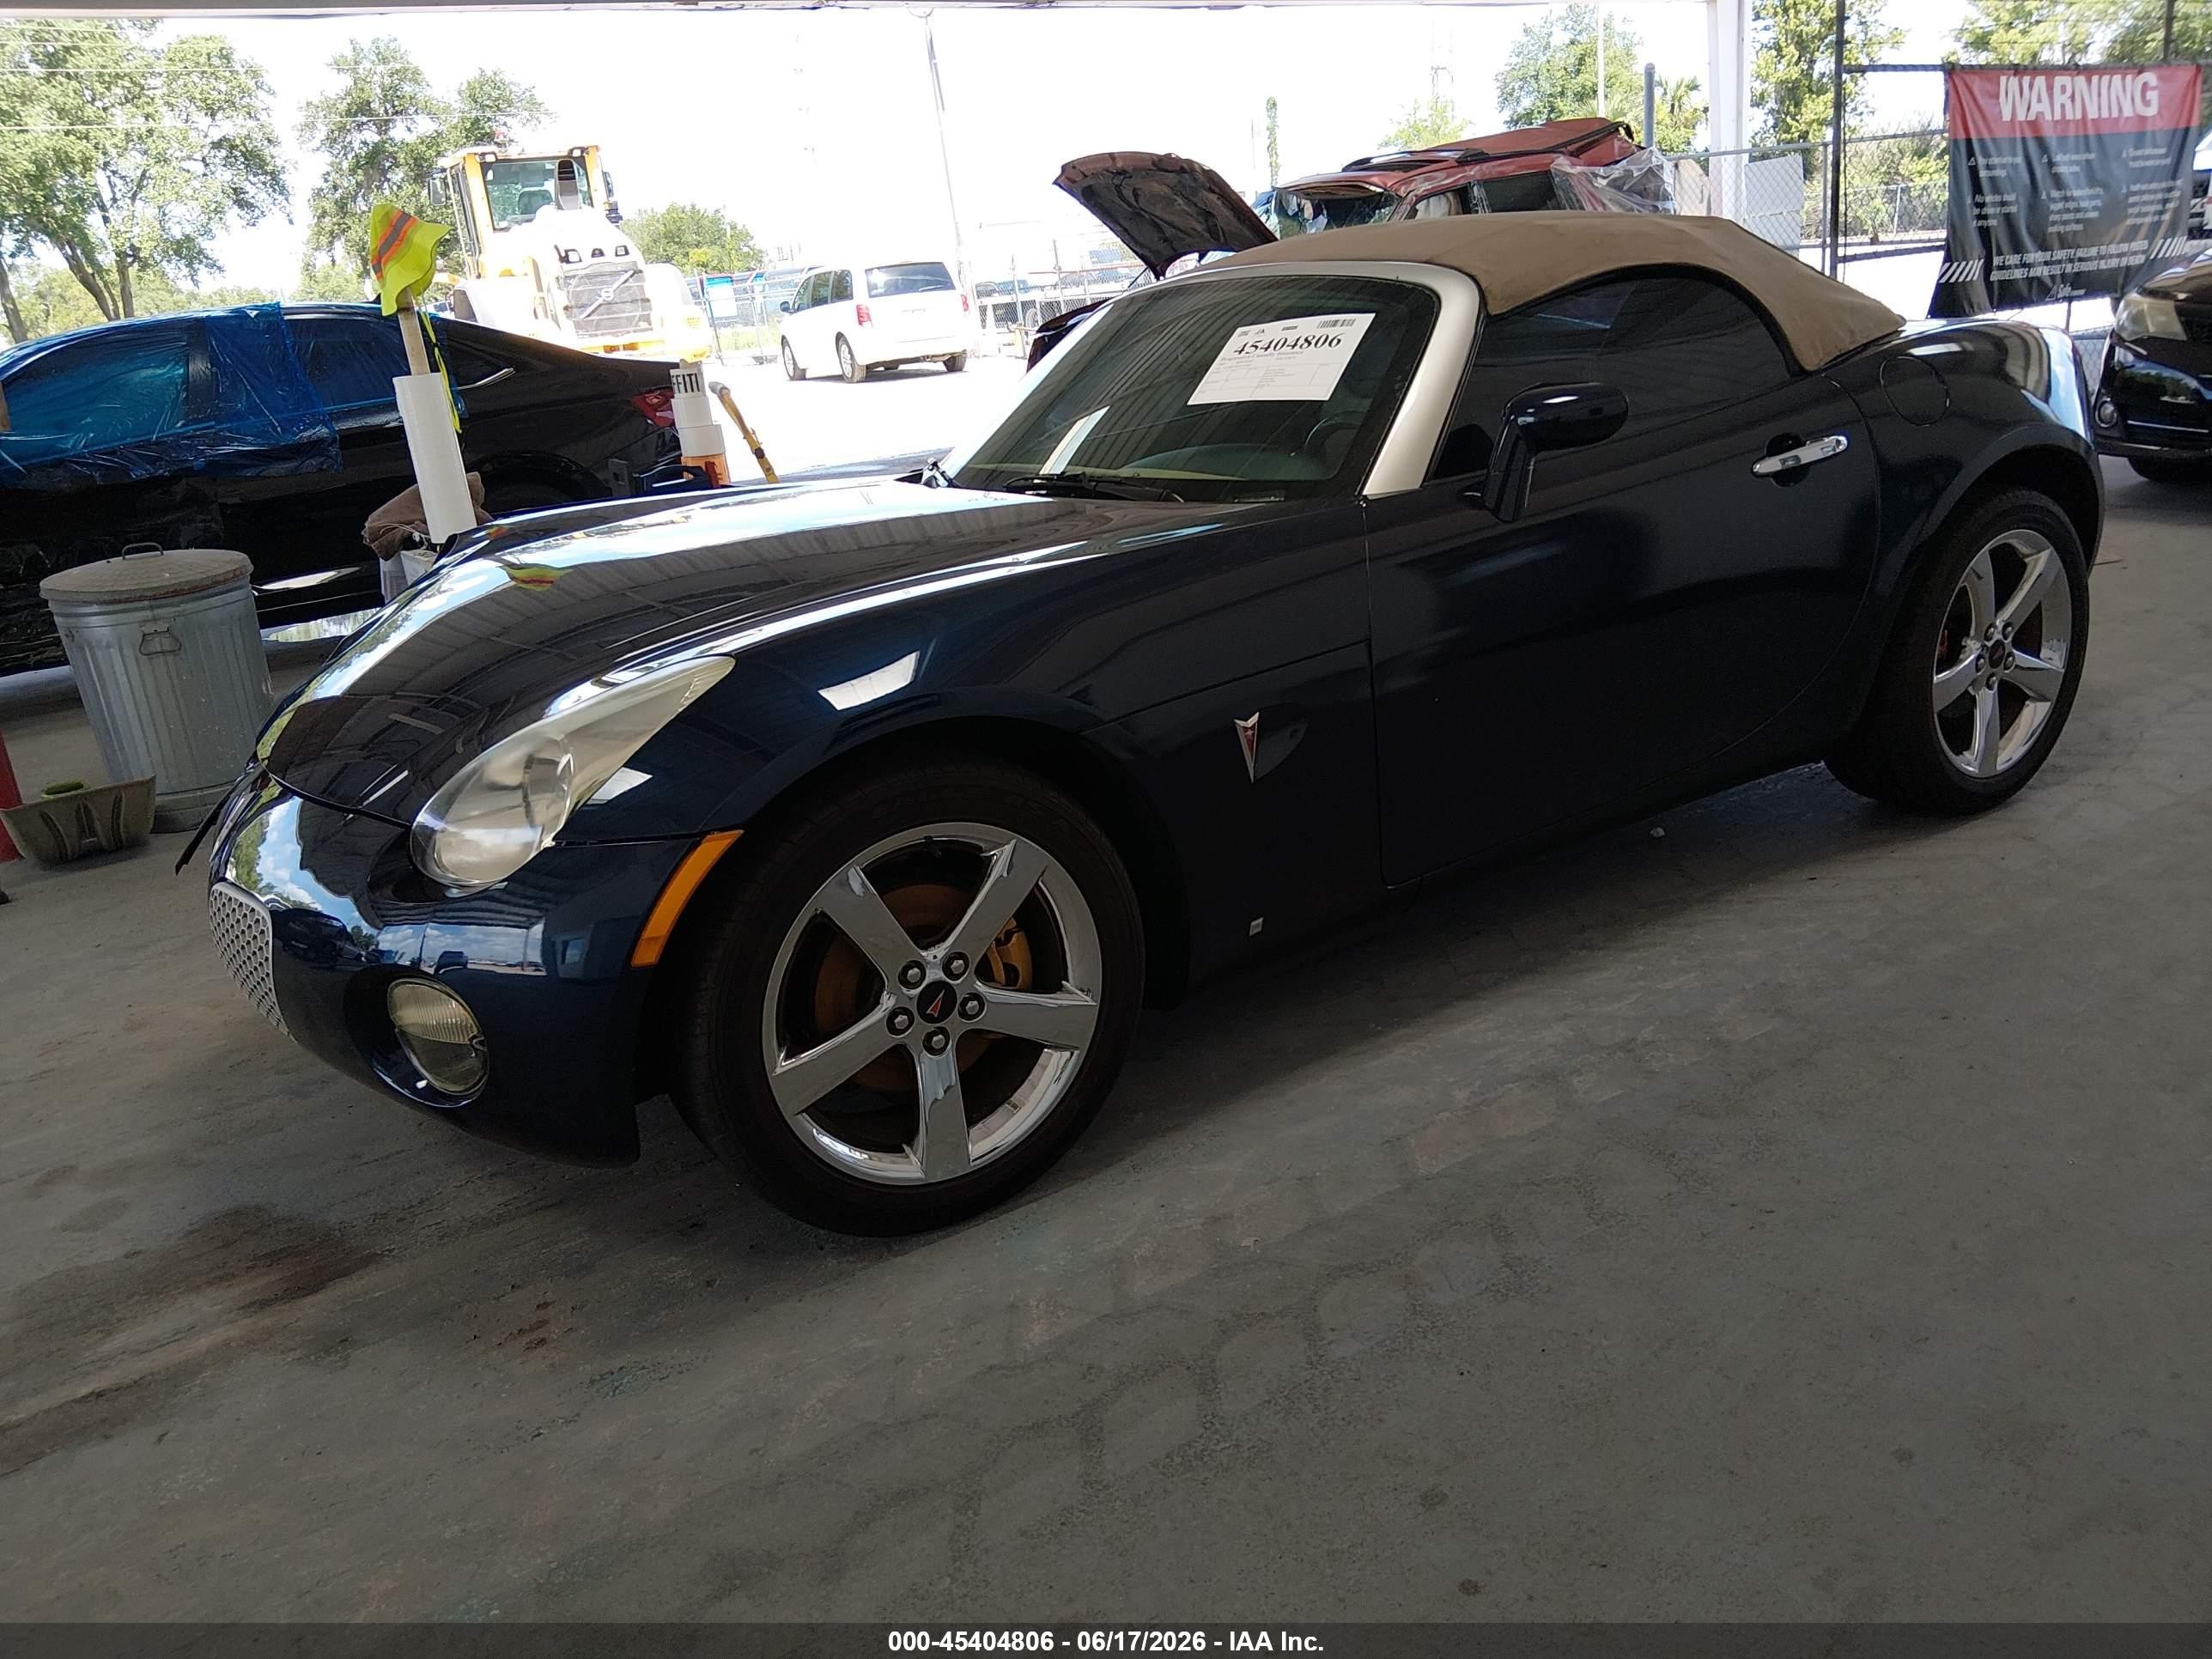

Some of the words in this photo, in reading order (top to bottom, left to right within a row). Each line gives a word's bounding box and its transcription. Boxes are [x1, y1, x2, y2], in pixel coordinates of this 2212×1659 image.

[1999, 72, 2159, 121] WARNING
[1993, 256, 2005, 266] WE
[2005, 254, 2022, 265] CARE
[2022, 253, 2034, 264] FOR
[2034, 251, 2051, 262] YOUR
[1990, 268, 2028, 282] GUIDELINES
[2028, 266, 2043, 277] MAY
[2043, 264, 2066, 276] RESULT
[2065, 263, 2073, 273] IN
[2073, 260, 2099, 272] SERIOUS
[1234, 332, 1346, 355] 45404806
